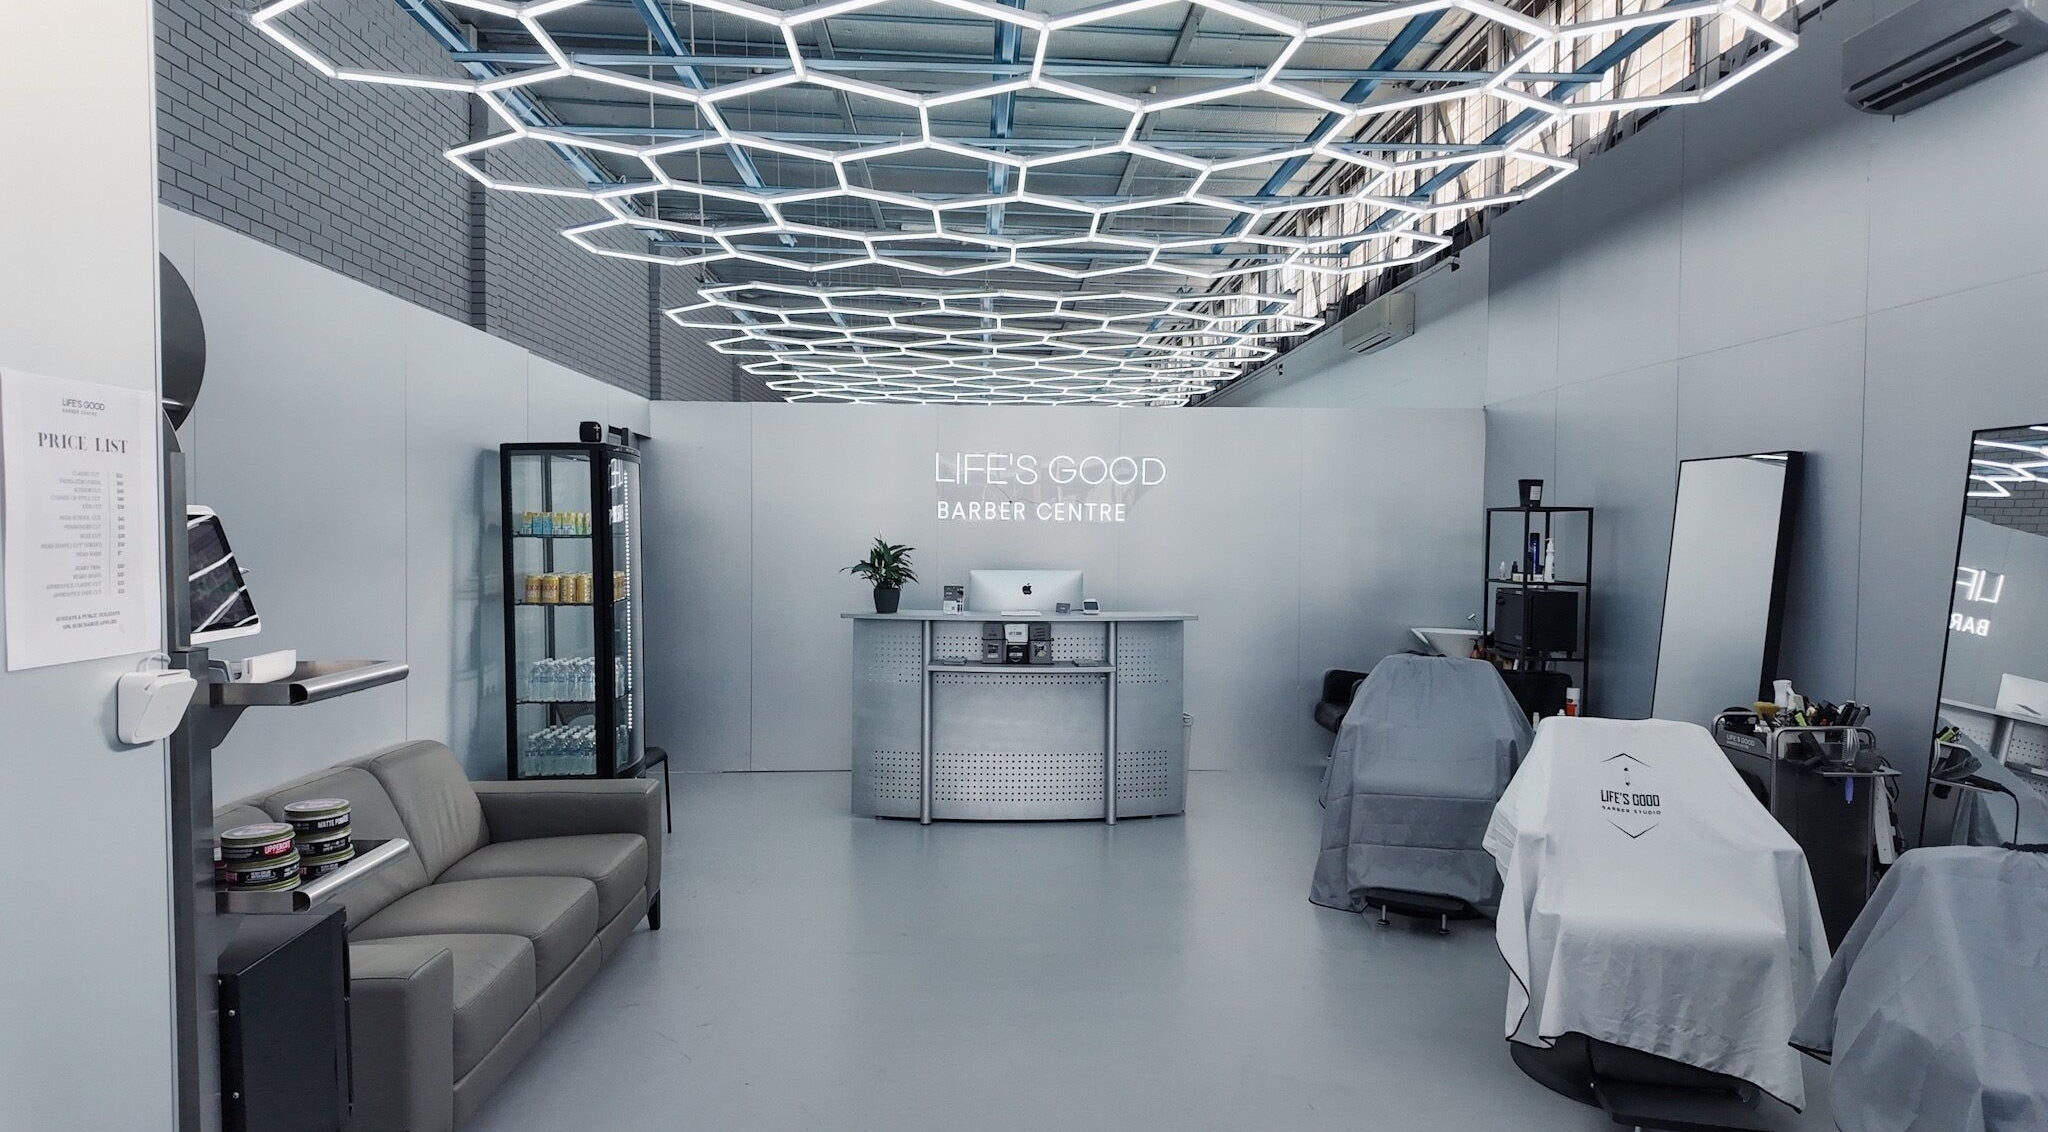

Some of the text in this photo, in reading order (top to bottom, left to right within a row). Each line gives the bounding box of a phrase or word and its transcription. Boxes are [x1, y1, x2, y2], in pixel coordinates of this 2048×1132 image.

[62, 398, 105, 411] LIFE'S GOOD
[38, 432, 128, 454] PRICE LIST
[935, 451, 1167, 486] LIFE'S GOOD
[937, 500, 1126, 522] BARBER CENTRE
[1600, 789, 1660, 807] LIFE'S GOOD
[1602, 805, 1630, 813] BARBER
[317, 818, 335, 829] MATTE
[264, 839, 291, 855] UPPERCUT
